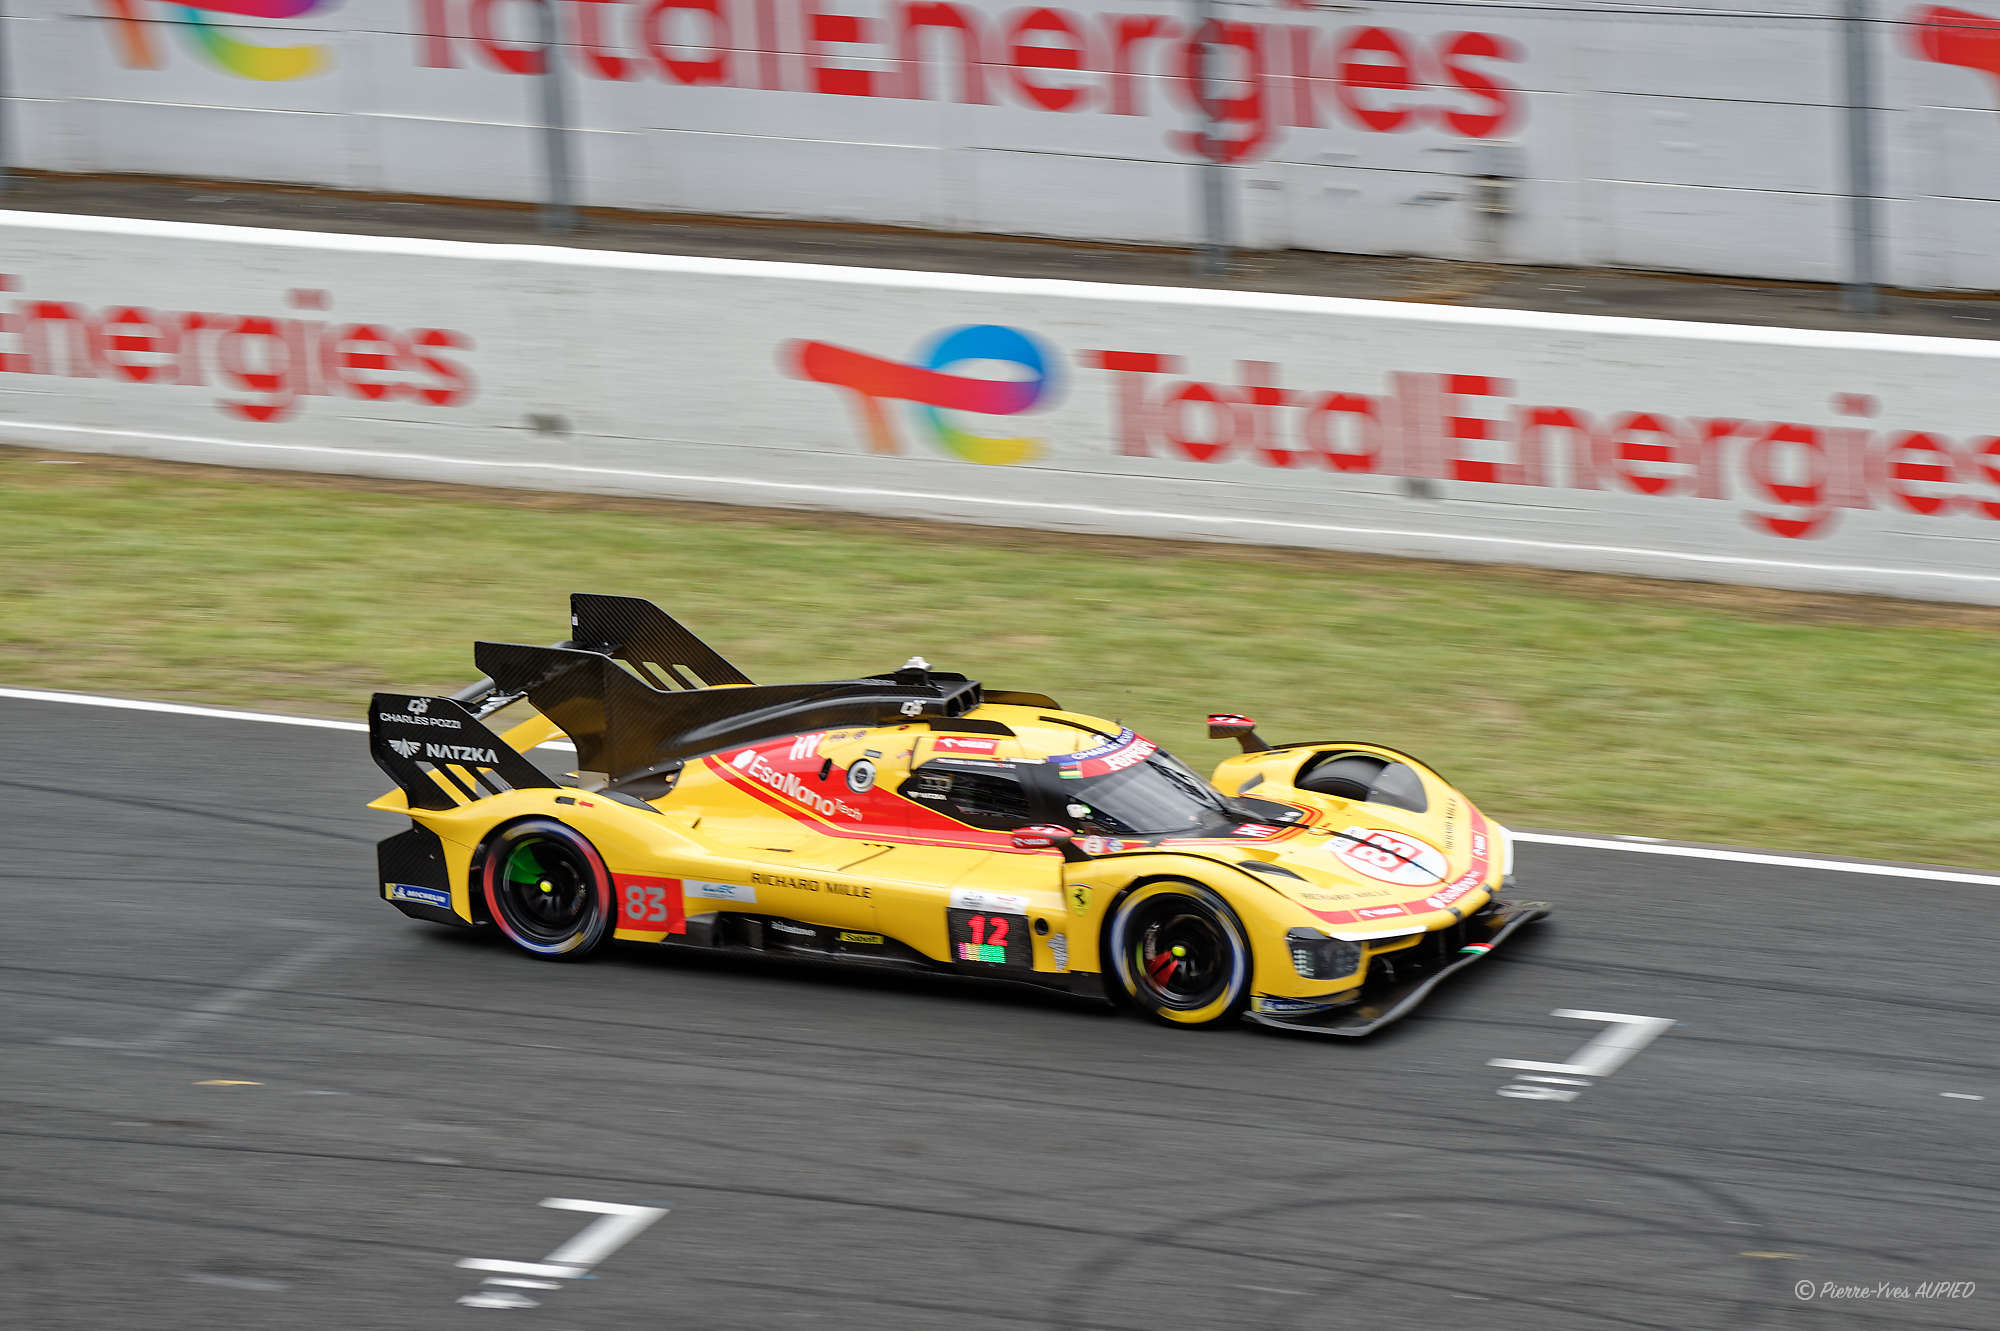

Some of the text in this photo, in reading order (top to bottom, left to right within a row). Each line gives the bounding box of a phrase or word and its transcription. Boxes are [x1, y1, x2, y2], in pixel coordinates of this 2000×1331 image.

[380, 712, 429, 726] CHARLES
[425, 742, 499, 763] NATZKA
[747, 755, 836, 816] EsaNano
[752, 872, 872, 898] RICHARD MILLE
[626, 885, 667, 922] 83
[967, 914, 1009, 947] 12
